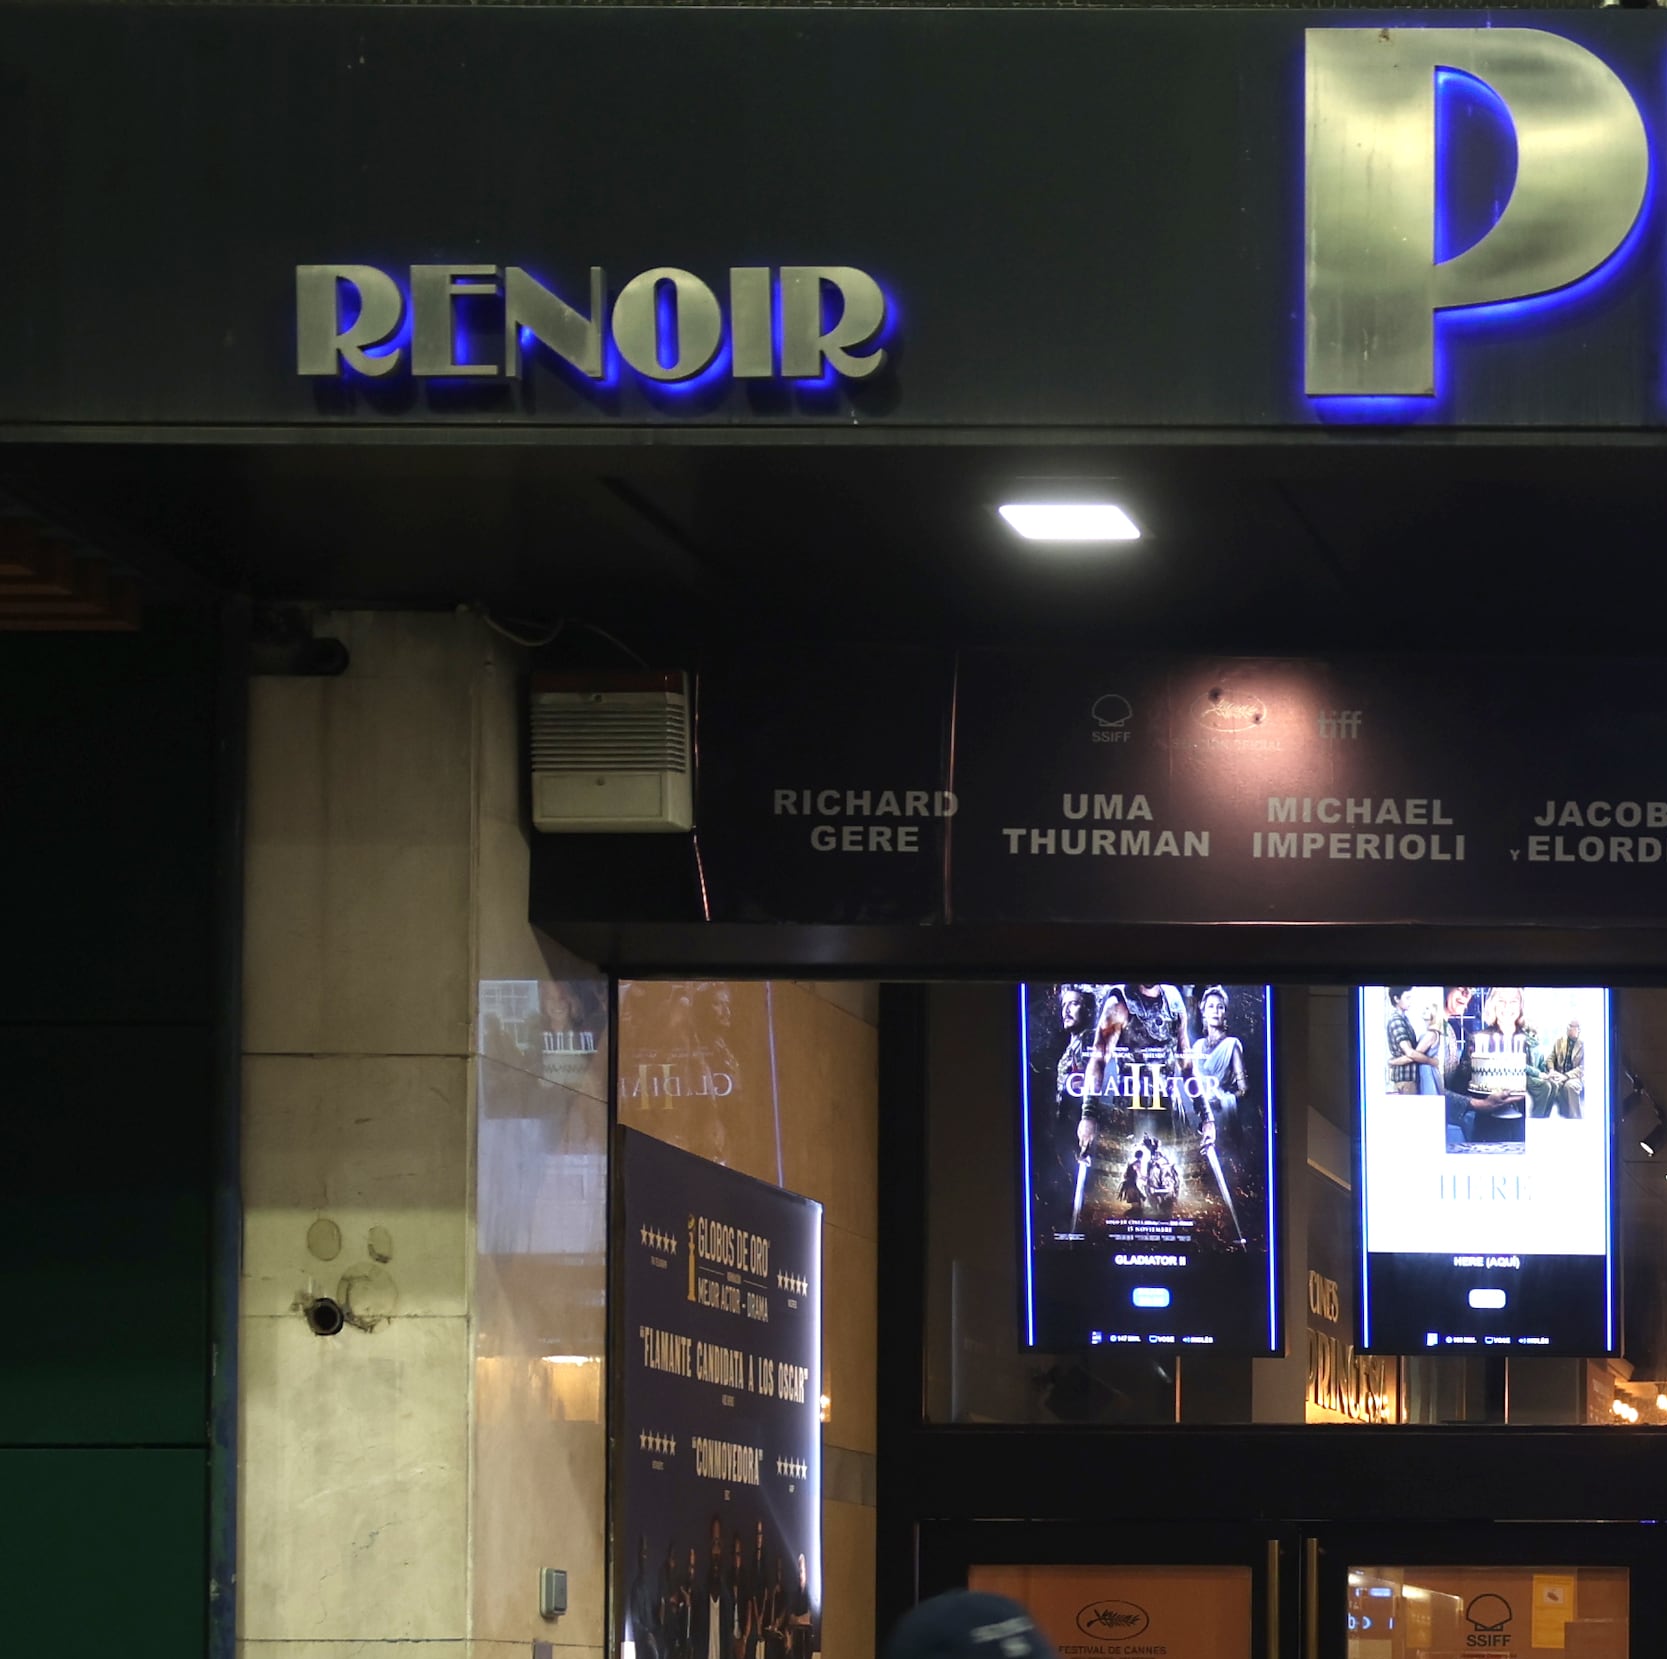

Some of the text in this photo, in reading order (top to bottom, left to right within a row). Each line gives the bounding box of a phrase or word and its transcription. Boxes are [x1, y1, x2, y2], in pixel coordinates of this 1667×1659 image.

[295, 263, 888, 380] RENOIR
[1091, 730, 1132, 743] SSIFF
[772, 788, 960, 819] RICHARD
[1061, 793, 1154, 821] UMA
[1266, 796, 1455, 826] MICHAEL
[809, 825, 921, 854] GERE
[1002, 827, 1212, 858] THURMAN
[1251, 830, 1466, 862] IMPERIOLI
[1509, 847, 1521, 863] Y
[1065, 1072, 1222, 1098] GLADIATOR
[697, 1214, 750, 1274] GLOBOS DE
[1114, 1254, 1178, 1266] GLADIATOR
[1453, 1254, 1521, 1270] HERE (AQUÍ)
[697, 1275, 721, 1308] MEJOR
[720, 1284, 741, 1315] ACTOR
[696, 1340, 745, 1390] CANDIDATA
[747, 1354, 755, 1393] A
[757, 1355, 775, 1398] LOS
[1058, 1645, 1168, 1656] FESTIVAL DE CANNES
[1466, 1634, 1512, 1647] SSIFF
